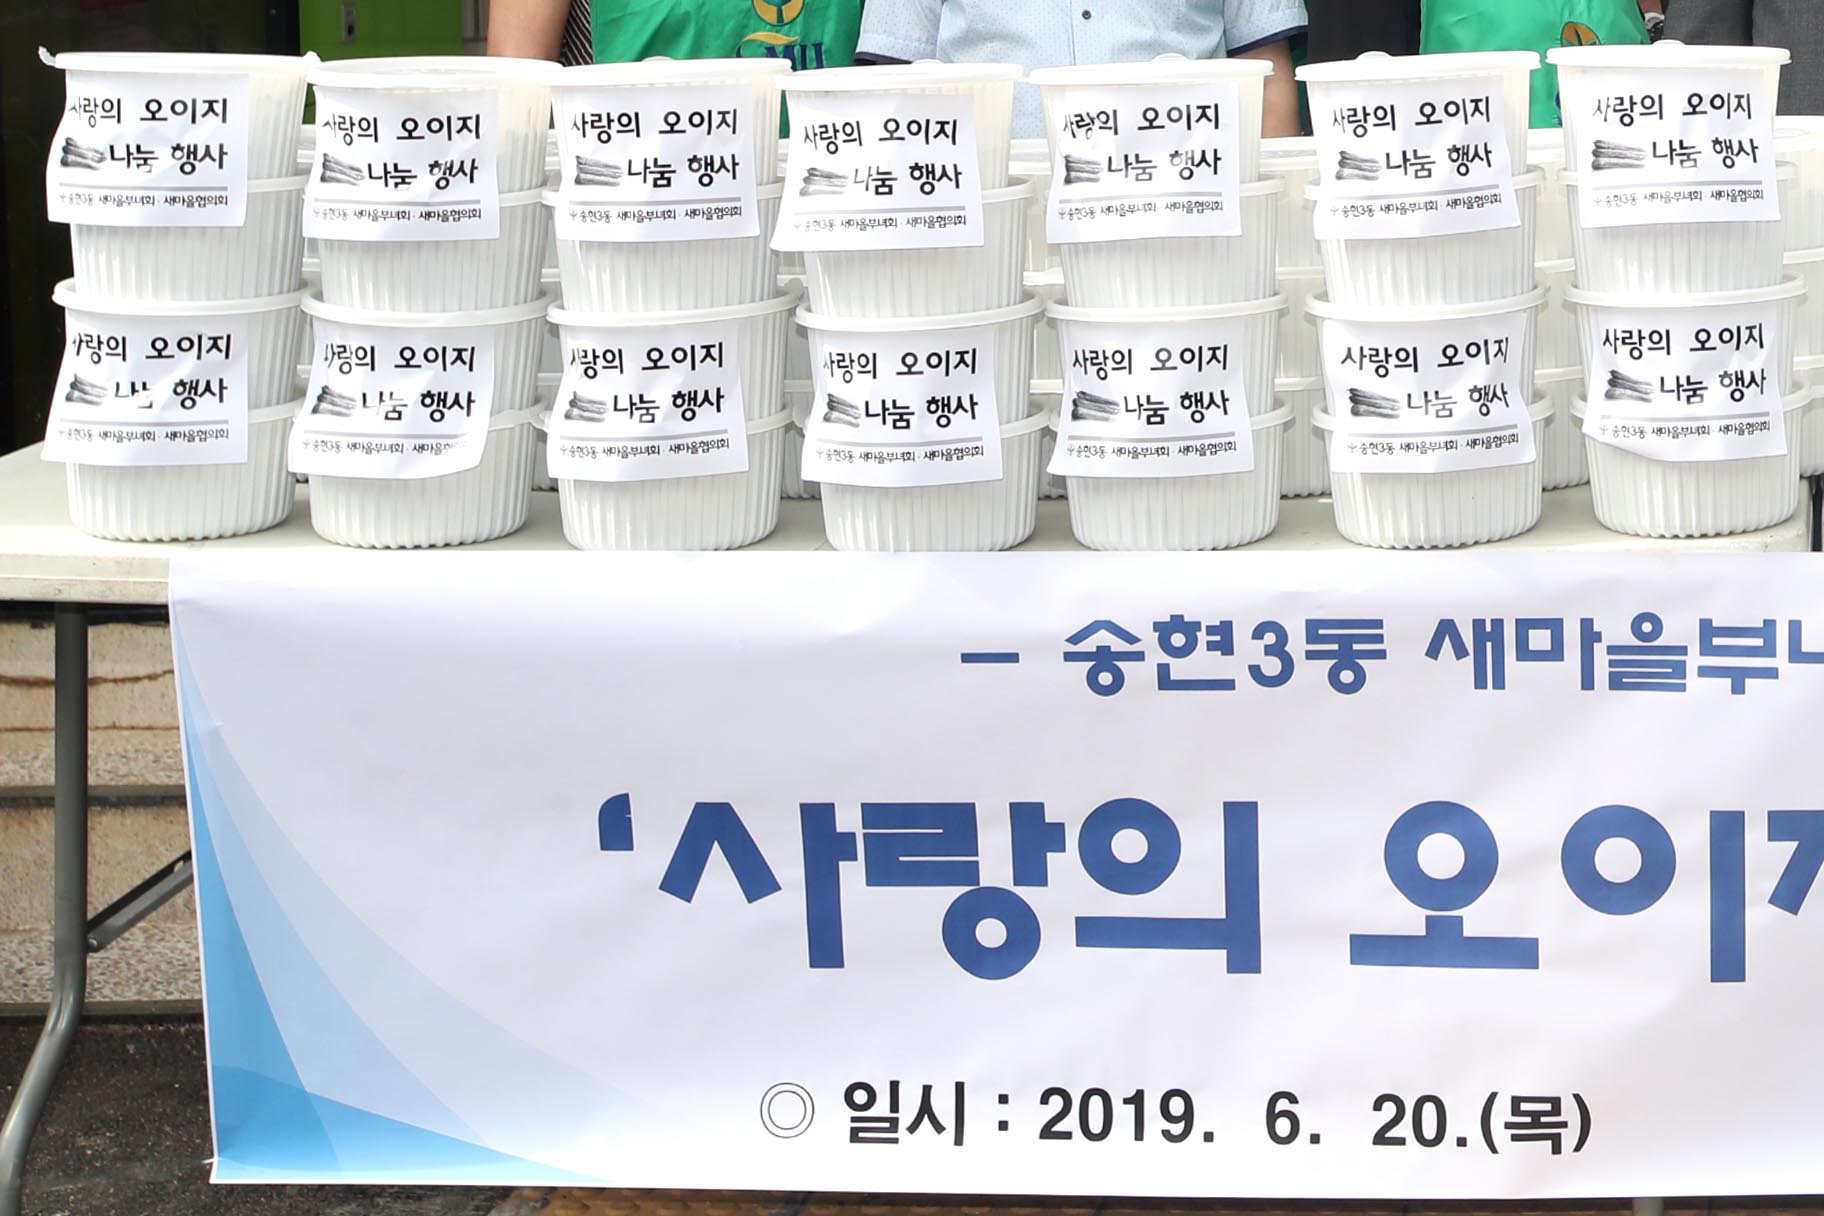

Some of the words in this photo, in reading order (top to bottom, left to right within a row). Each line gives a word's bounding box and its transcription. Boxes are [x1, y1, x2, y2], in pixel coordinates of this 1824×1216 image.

[69, 97, 122, 129] 사랑의
[139, 97, 228, 125] 오이지
[573, 111, 641, 145] 사랑의
[658, 108, 737, 136] 오이지
[1333, 104, 1396, 139] 사랑의
[1414, 95, 1491, 126] 오이지
[1596, 93, 1664, 128] 사랑의
[1682, 92, 1752, 120] 오이지
[108, 143, 159, 169] 나눔
[170, 142, 229, 176] 행사
[627, 157, 677, 189] 나눔
[686, 153, 740, 188] 행사
[1385, 148, 1437, 180] 나눔
[1446, 141, 1493, 177] 행사
[1652, 139, 1702, 168] 나눔
[1711, 136, 1759, 170] 행사
[1602, 328, 1671, 361] 사랑의
[1689, 322, 1764, 352] 오이지
[828, 351, 877, 384] 사랑의
[895, 347, 977, 377] 오이지
[1072, 348, 1133, 381] 사랑의
[1150, 343, 1228, 373] 오이지
[1660, 374, 1709, 405] 나눔
[1718, 367, 1767, 403] 행사
[864, 398, 916, 430] 나눔
[925, 393, 979, 429] 행사
[1123, 394, 1170, 426] 나눔
[1179, 389, 1230, 424] 행사
[1062, 614, 1388, 697] 송현3동
[843, 1079, 966, 1147] 일시
[1038, 1086, 1215, 1144] 2019.
[1265, 1090, 1321, 1146] 6.
[1371, 1091, 1592, 1156] 20.(목)
